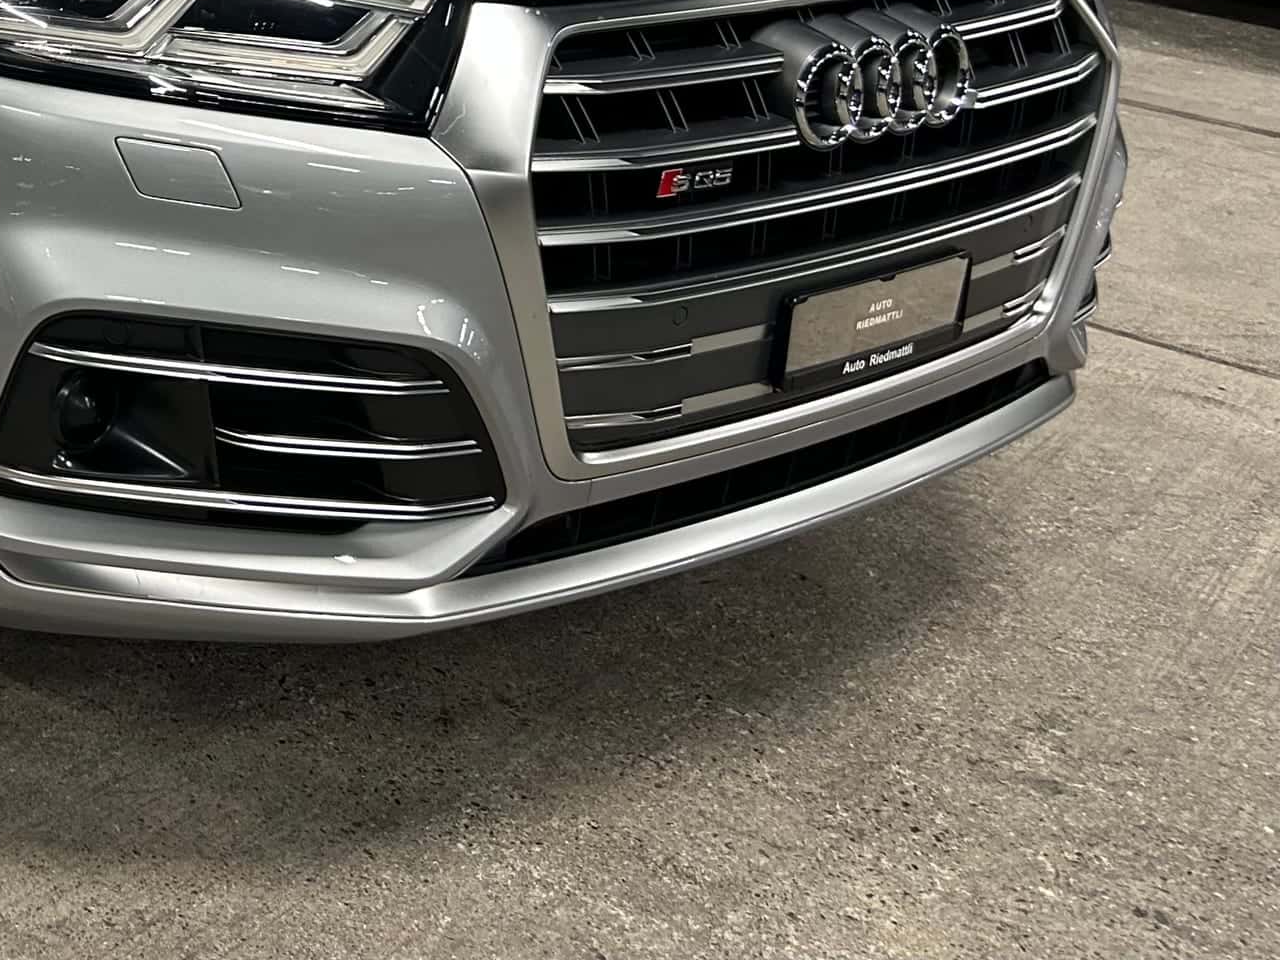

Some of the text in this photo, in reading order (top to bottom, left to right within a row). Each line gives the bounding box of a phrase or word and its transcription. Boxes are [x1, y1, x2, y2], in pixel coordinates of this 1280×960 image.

[665, 167, 733, 194] SQ5
[869, 298, 892, 313] AUTO
[856, 309, 904, 330] RIEDMATTLI
[842, 342, 914, 375] Auto Riedmattli
